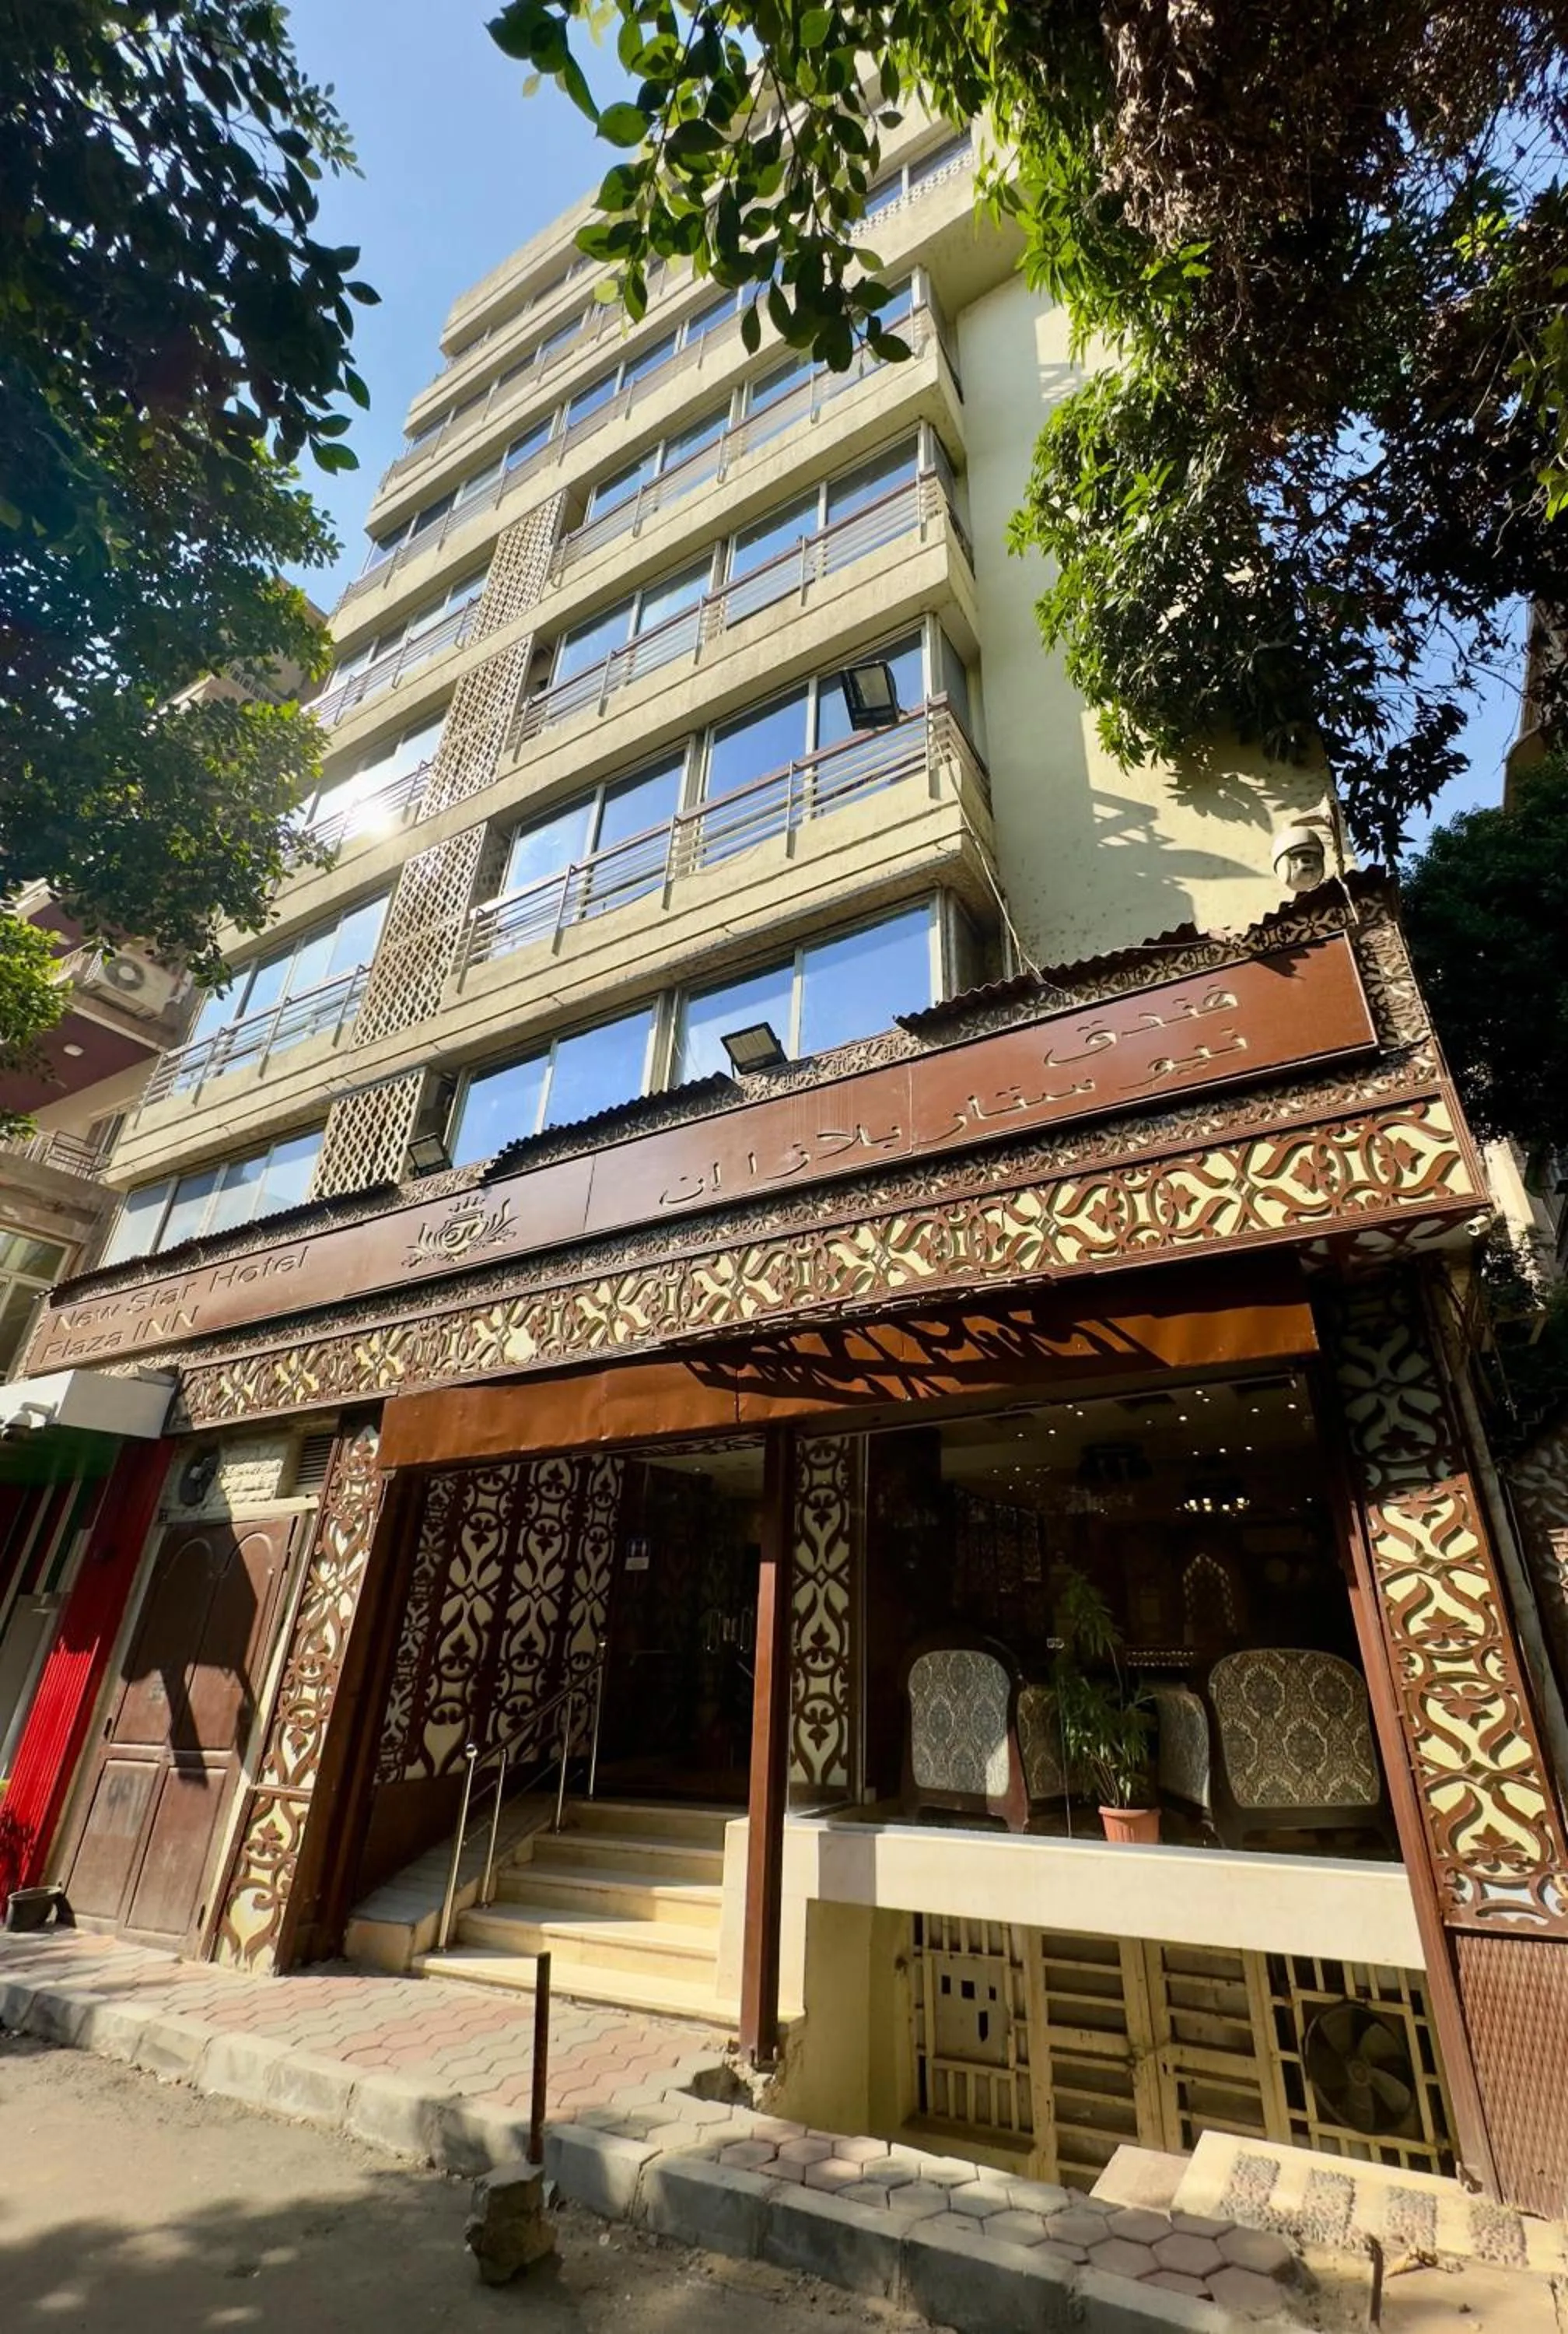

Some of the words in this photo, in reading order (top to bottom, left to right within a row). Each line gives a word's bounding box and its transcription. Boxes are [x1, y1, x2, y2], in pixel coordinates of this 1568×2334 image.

[1043, 984, 1238, 1067] فندق
[1118, 1027, 1248, 1091] نيو
[912, 1078, 1096, 1147] ستار
[747, 1123, 902, 1181] بلازا
[51, 1302, 121, 1333] New
[126, 1281, 198, 1315] Star
[208, 1246, 310, 1294] Hotel
[40, 1329, 125, 1365] Plaza
[132, 1304, 201, 1344] INN
